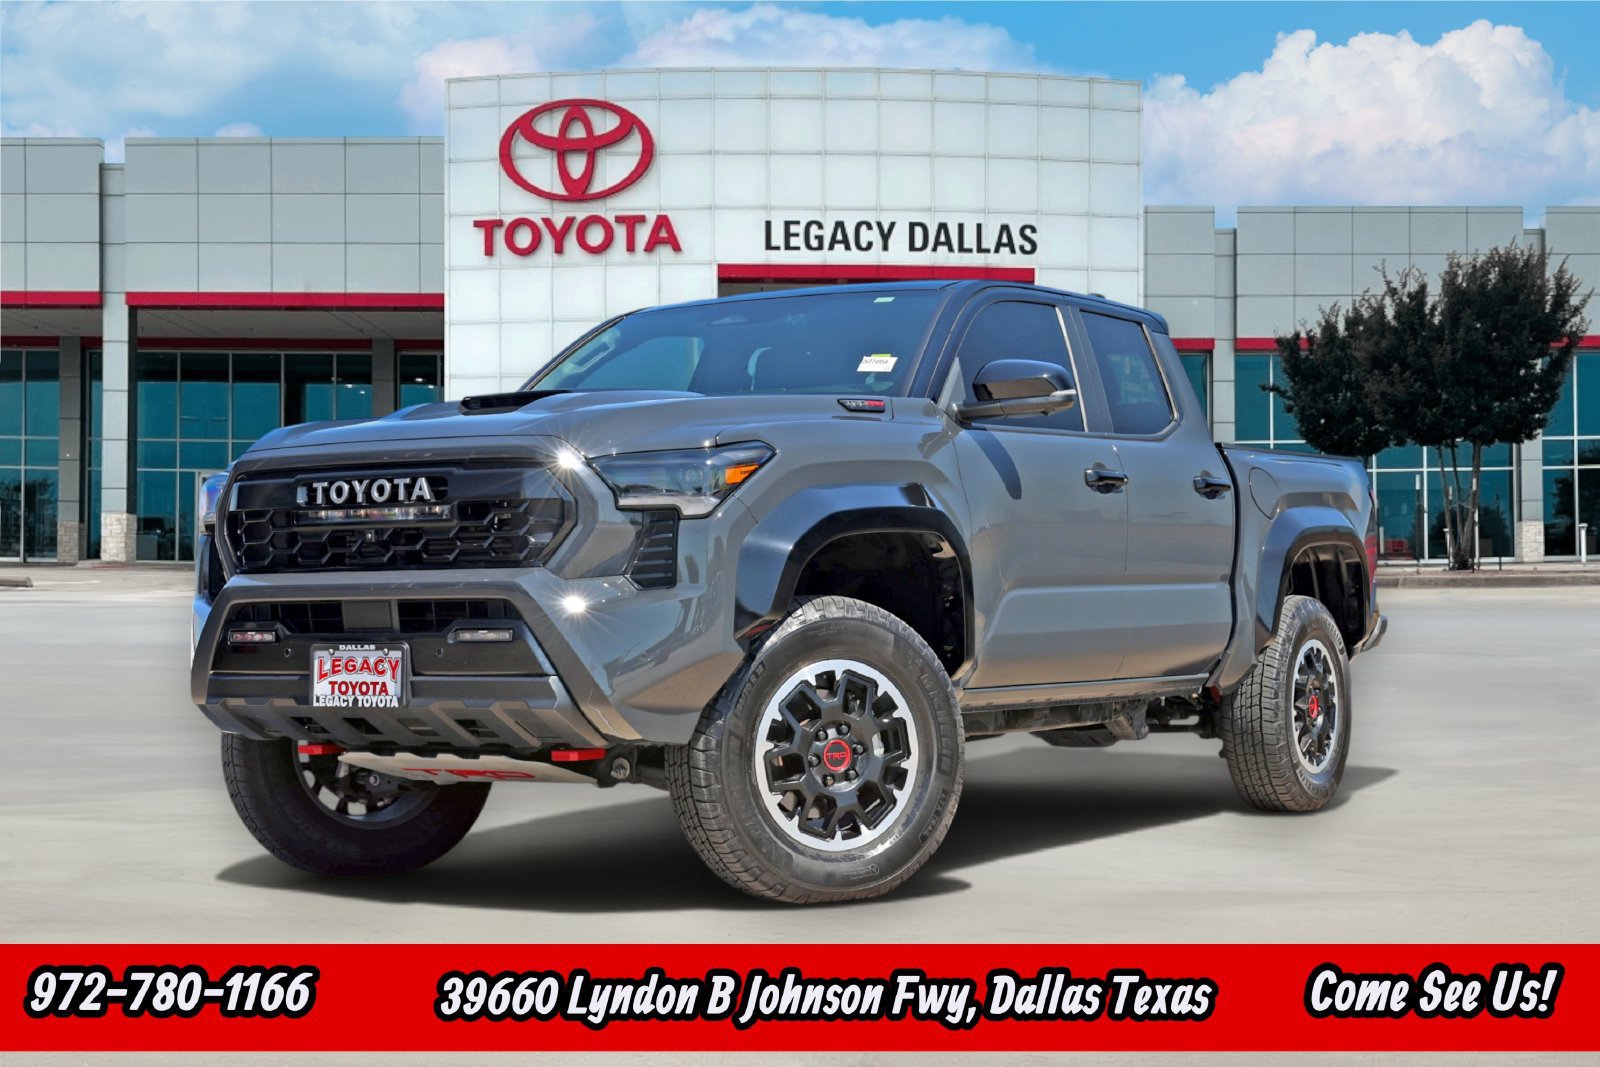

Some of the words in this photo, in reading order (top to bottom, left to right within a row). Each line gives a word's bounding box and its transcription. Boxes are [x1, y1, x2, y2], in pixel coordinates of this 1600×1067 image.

[473, 215, 682, 256] TOYOTA
[765, 220, 896, 251] LEGACY
[908, 222, 1038, 255] DALLAS
[312, 477, 434, 504] TOYOTA
[317, 656, 400, 684] LEGACY
[313, 695, 354, 708] LEGACY
[357, 695, 399, 708] TOYOTA
[329, 681, 389, 696] TOYOTA
[826, 752, 847, 760] TRD
